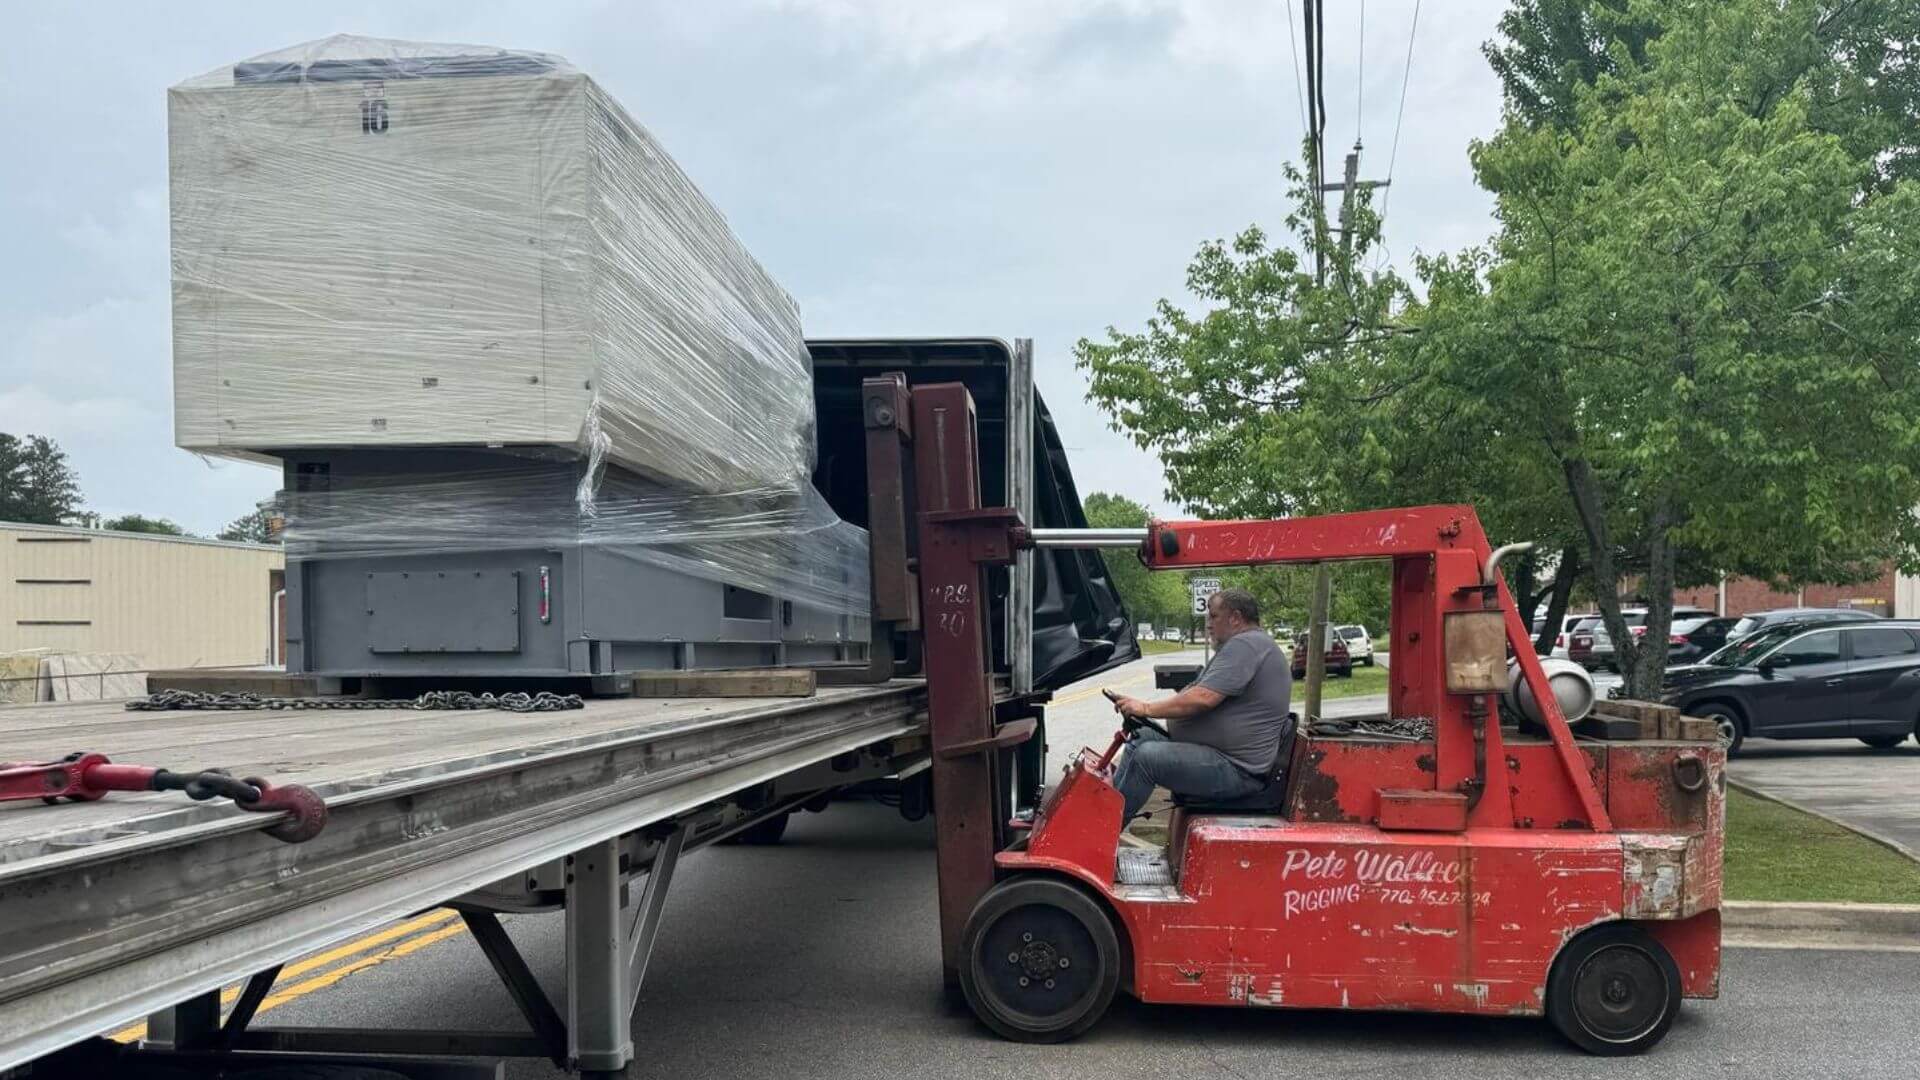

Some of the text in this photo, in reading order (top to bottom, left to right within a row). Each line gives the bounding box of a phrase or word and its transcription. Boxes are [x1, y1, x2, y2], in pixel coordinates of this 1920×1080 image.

[359, 100, 389, 136] 16
[1283, 849, 1347, 881] Pete
[1285, 884, 1360, 920] RIGGING
